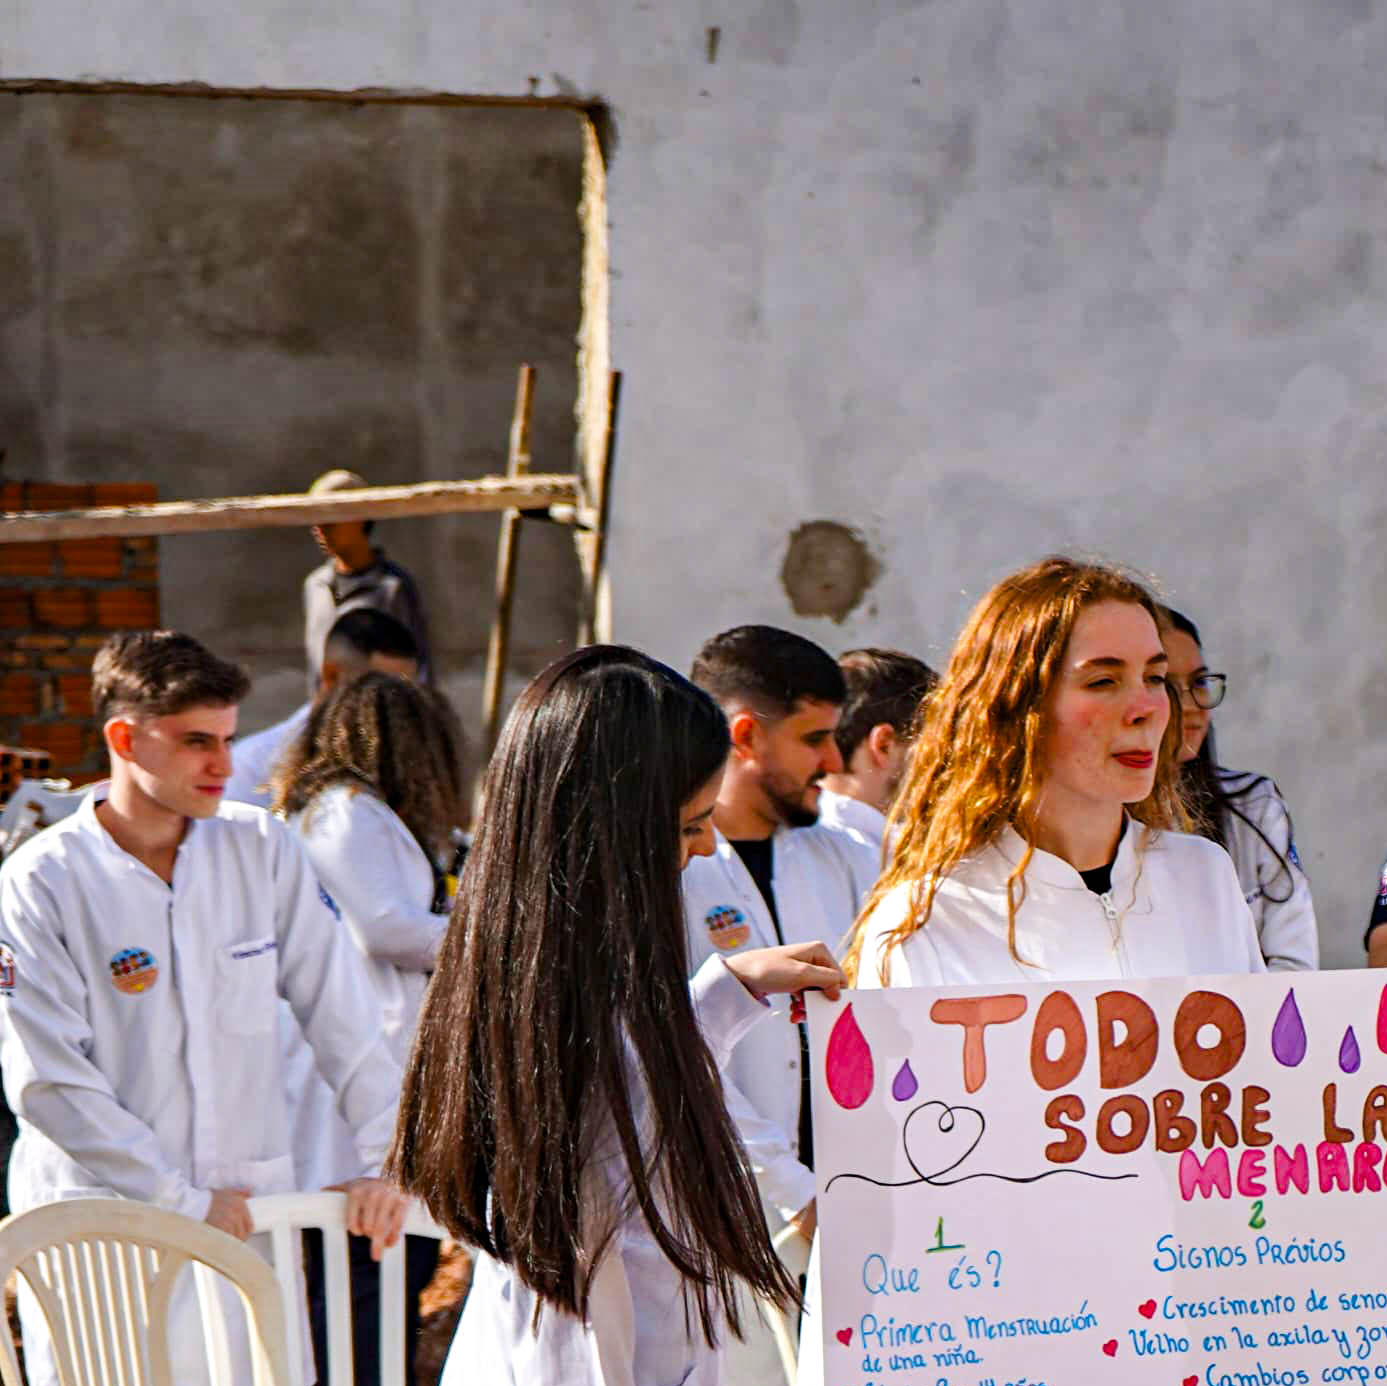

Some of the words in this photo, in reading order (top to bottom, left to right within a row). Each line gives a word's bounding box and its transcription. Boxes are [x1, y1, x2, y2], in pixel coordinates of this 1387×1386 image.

[929, 989, 1247, 1095] TODO
[1043, 1083, 1274, 1164] SOBRE
[1247, 1199, 1268, 1230] 2
[925, 1215, 967, 1254] 1
[862, 1252, 921, 1297] Que
[1161, 1293, 1297, 1320] Crescimento
[1305, 1288, 1329, 1313] de
[860, 1312, 957, 1350] Primera
[1202, 1335, 1228, 1352] en
[1230, 1326, 1259, 1350] la
[1266, 1324, 1330, 1348] axila
[1330, 1330, 1352, 1360] y
[861, 1354, 883, 1374] de
[888, 1352, 928, 1371] una
